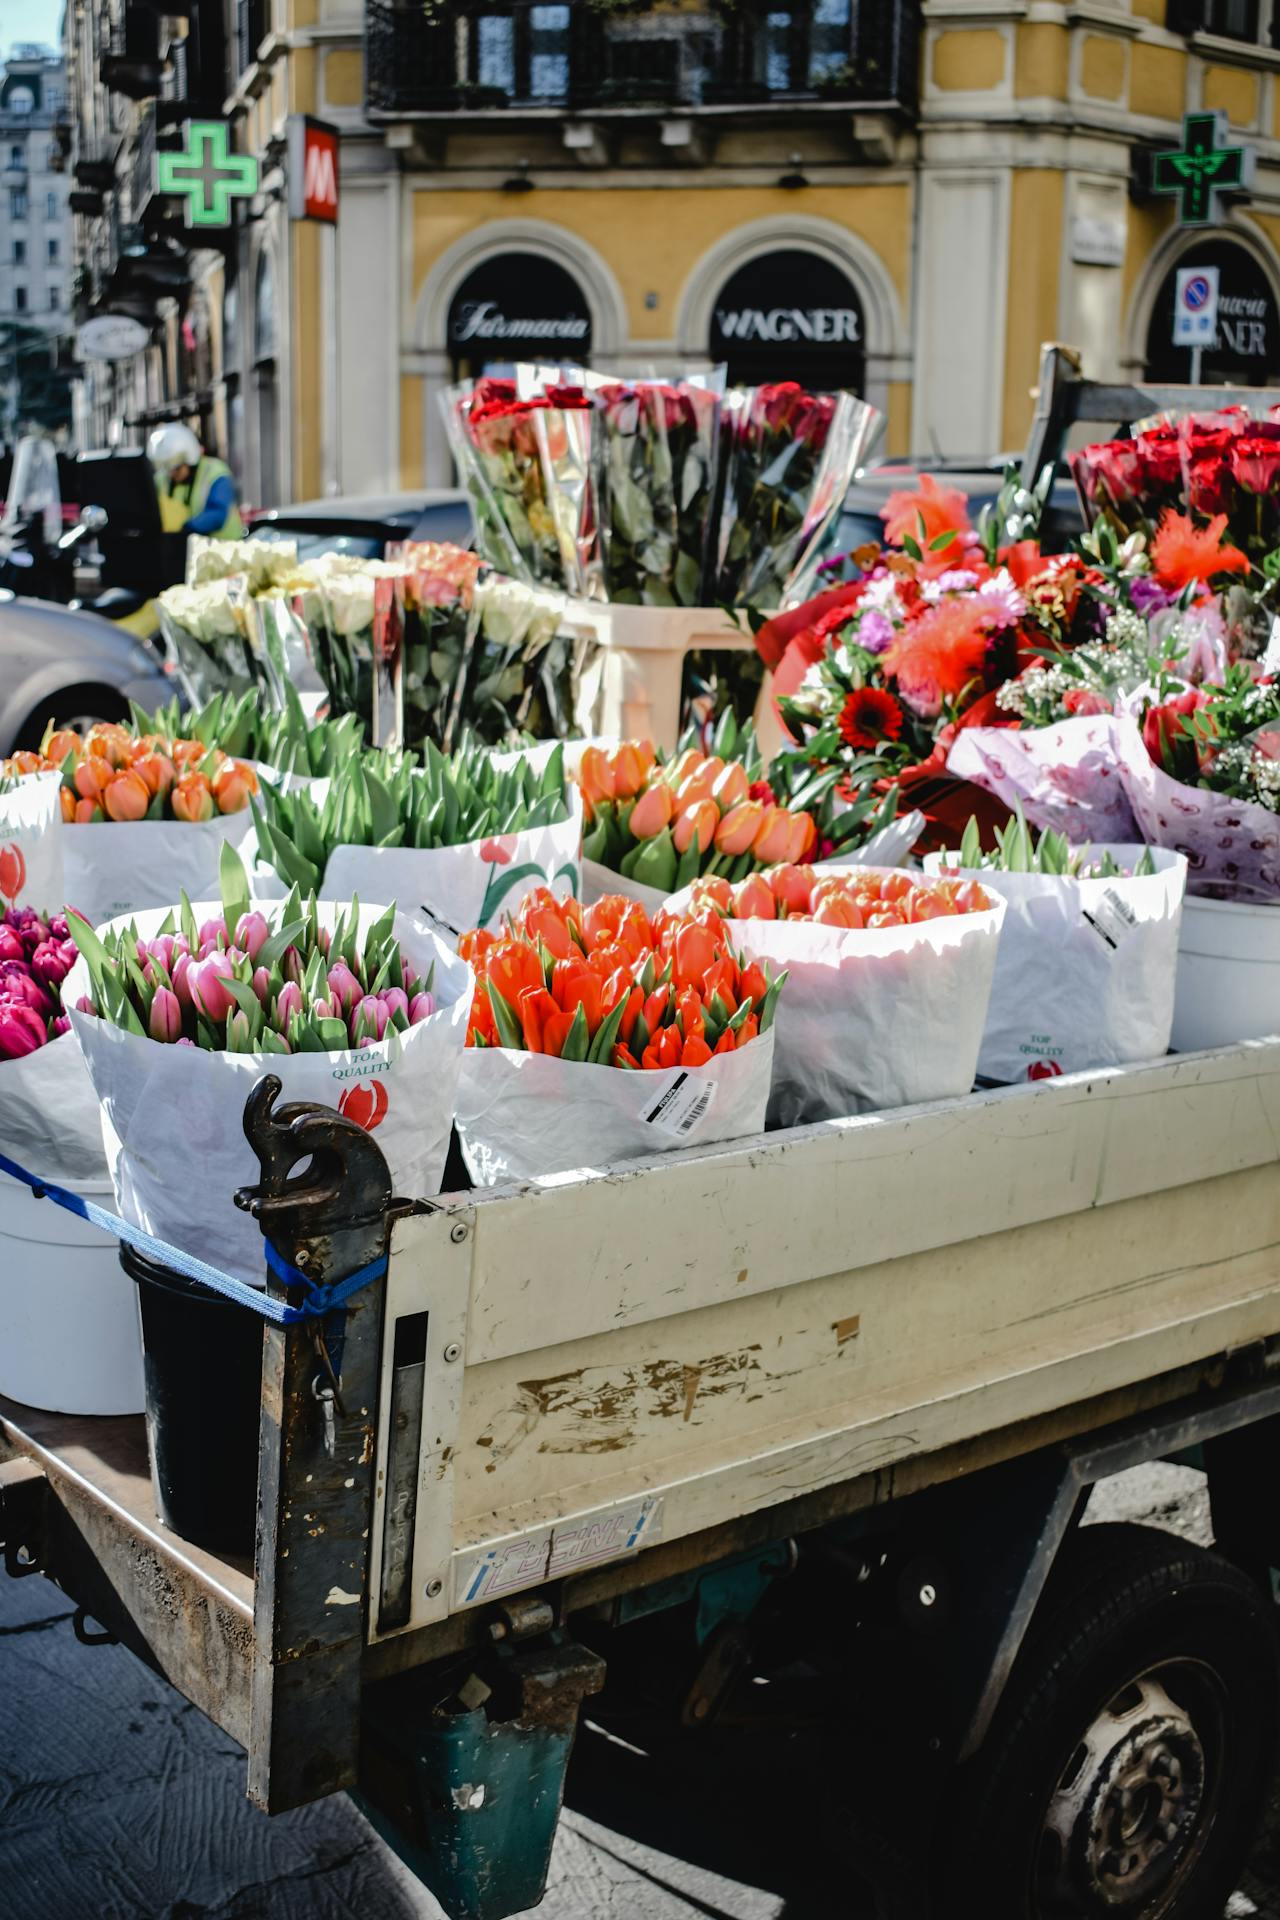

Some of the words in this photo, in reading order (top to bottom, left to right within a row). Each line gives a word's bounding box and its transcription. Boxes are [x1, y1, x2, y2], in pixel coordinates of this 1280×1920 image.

[304, 145, 337, 205] M
[716, 308, 860, 342] WAGNER
[332, 1060, 393, 1080] QUALITY
[352, 1051, 380, 1064] TOP
